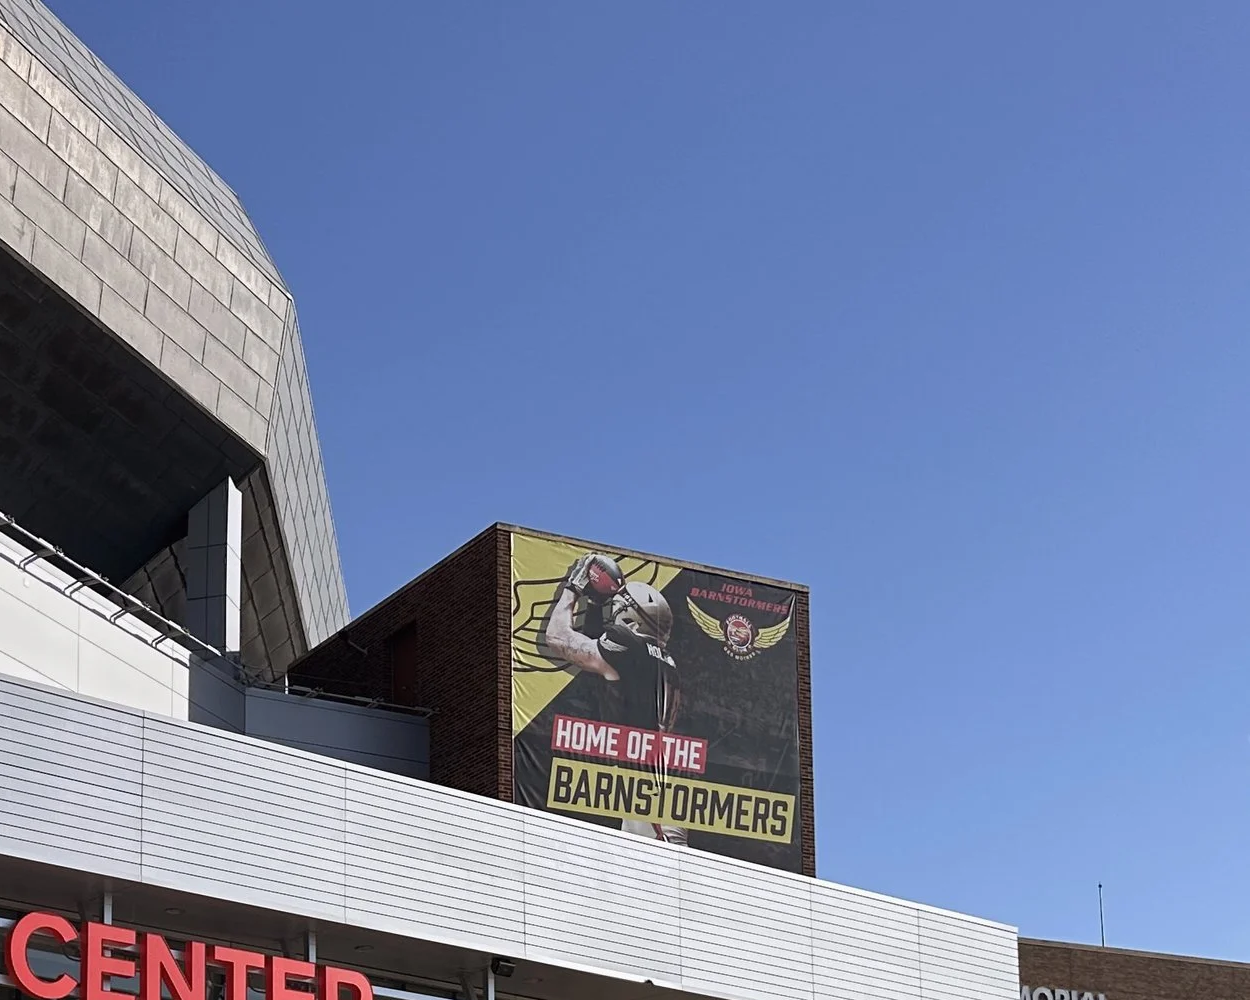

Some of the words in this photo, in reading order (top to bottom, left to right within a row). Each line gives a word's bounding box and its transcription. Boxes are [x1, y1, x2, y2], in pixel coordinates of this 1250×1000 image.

[690, 587, 789, 615] BARNSTORMERS
[722, 583, 753, 597] IOWA
[555, 719, 620, 757] HOME
[627, 733, 655, 761] OF
[662, 736, 703, 770] THE
[553, 765, 791, 837] BARNSTORMERS
